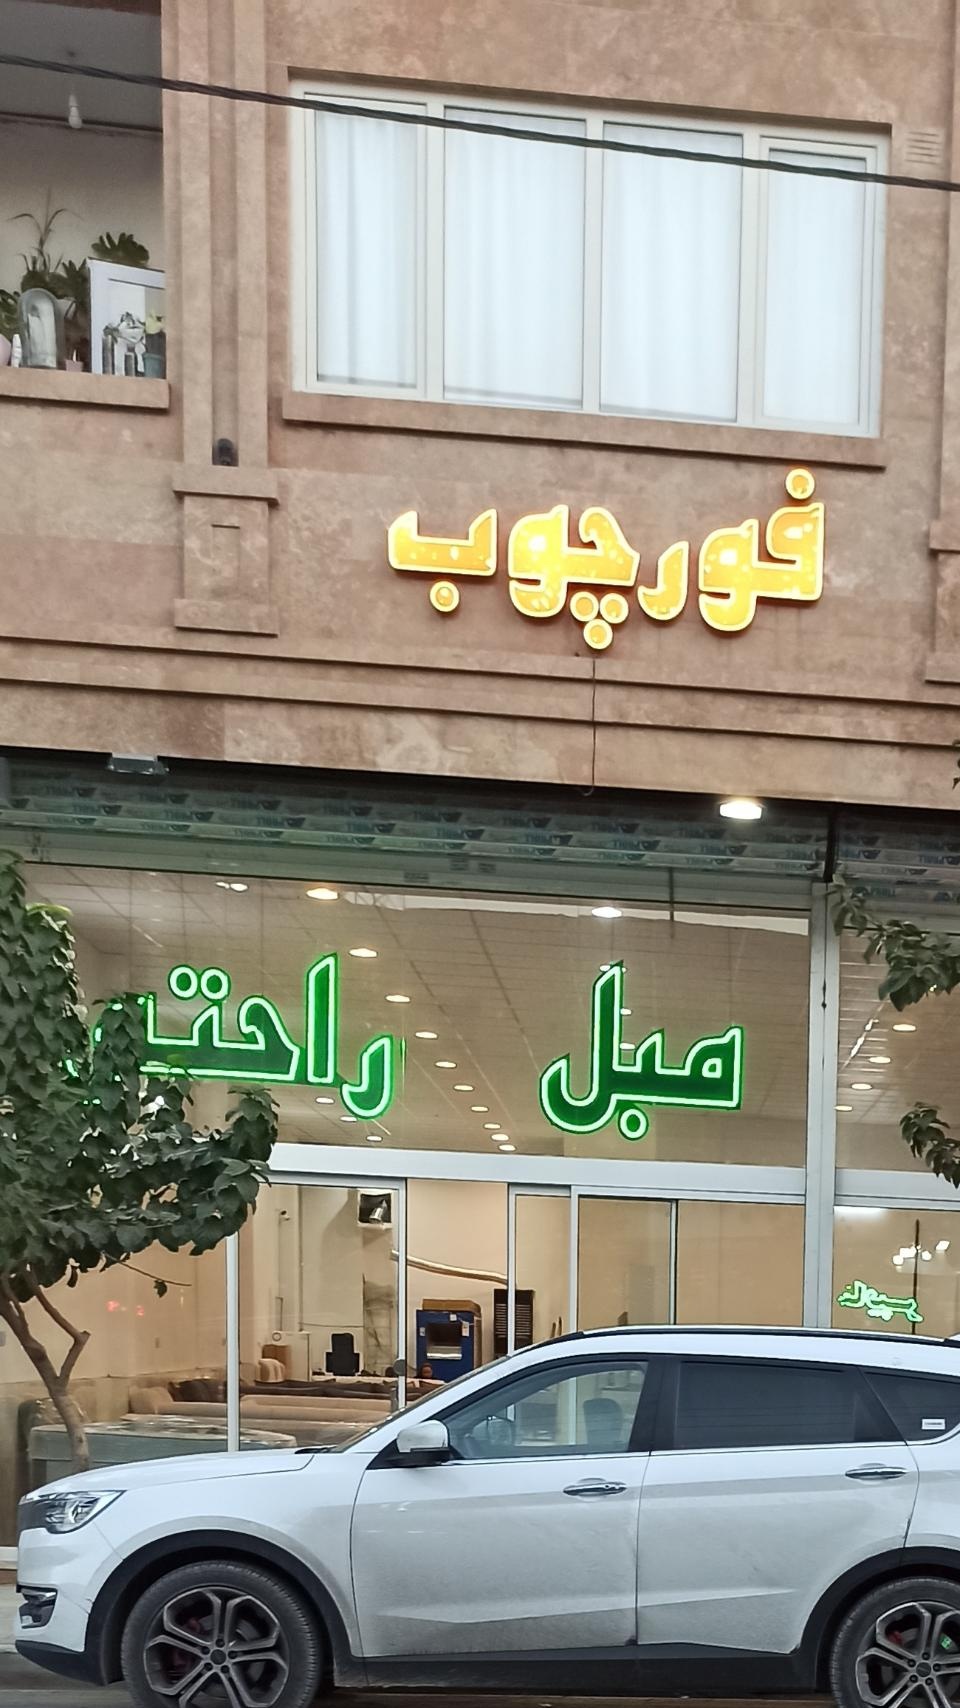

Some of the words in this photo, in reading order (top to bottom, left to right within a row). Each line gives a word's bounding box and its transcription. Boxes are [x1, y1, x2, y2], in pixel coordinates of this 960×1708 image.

[387, 467, 825, 650] فورچوب
[66, 952, 396, 1120] راحت
[538, 961, 745, 1141] مبل
